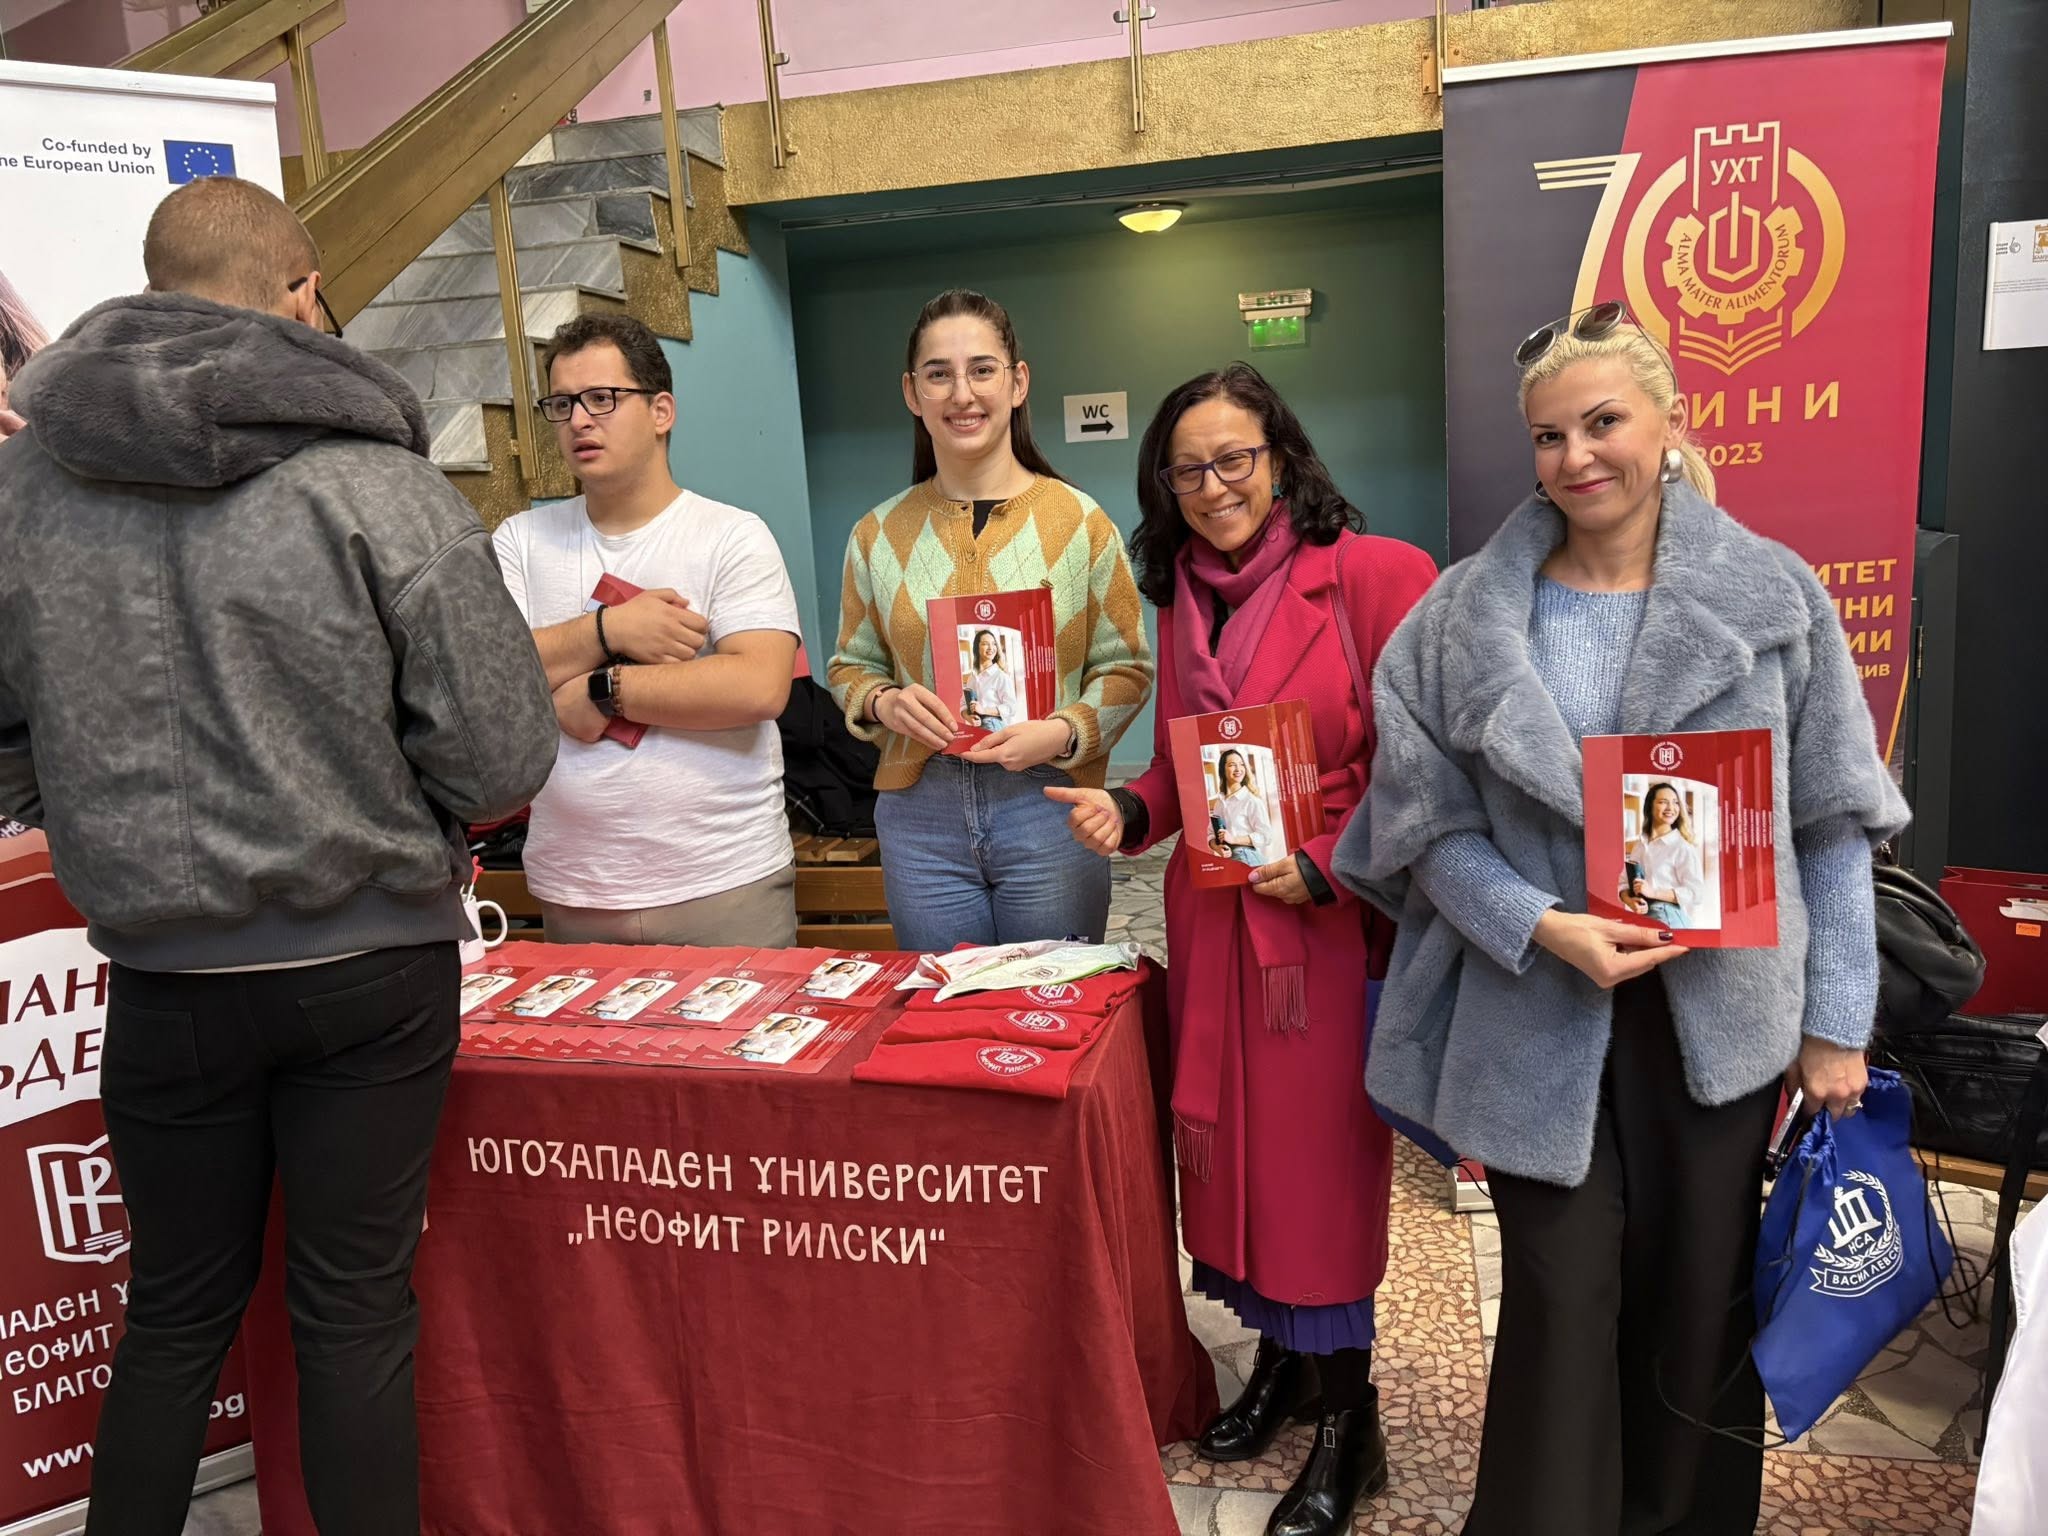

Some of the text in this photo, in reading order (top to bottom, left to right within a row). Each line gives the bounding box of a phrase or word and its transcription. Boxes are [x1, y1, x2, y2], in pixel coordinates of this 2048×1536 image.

[42, 137, 152, 158] Co-funded by
[23, 155, 103, 173] European
[107, 160, 155, 175] Union
[1710, 155, 1763, 186] УХТ
[1677, 223, 1790, 310] ALMA MATER ALIMENTORUM
[1082, 404, 1109, 419] WC
[467, 1137, 1049, 1204] ЮГОЗАПАДЕН УНИВЕРСИТЕТ
[1848, 1232, 1876, 1255] НСА
[1832, 1269, 1870, 1286] ВАСИЛ
